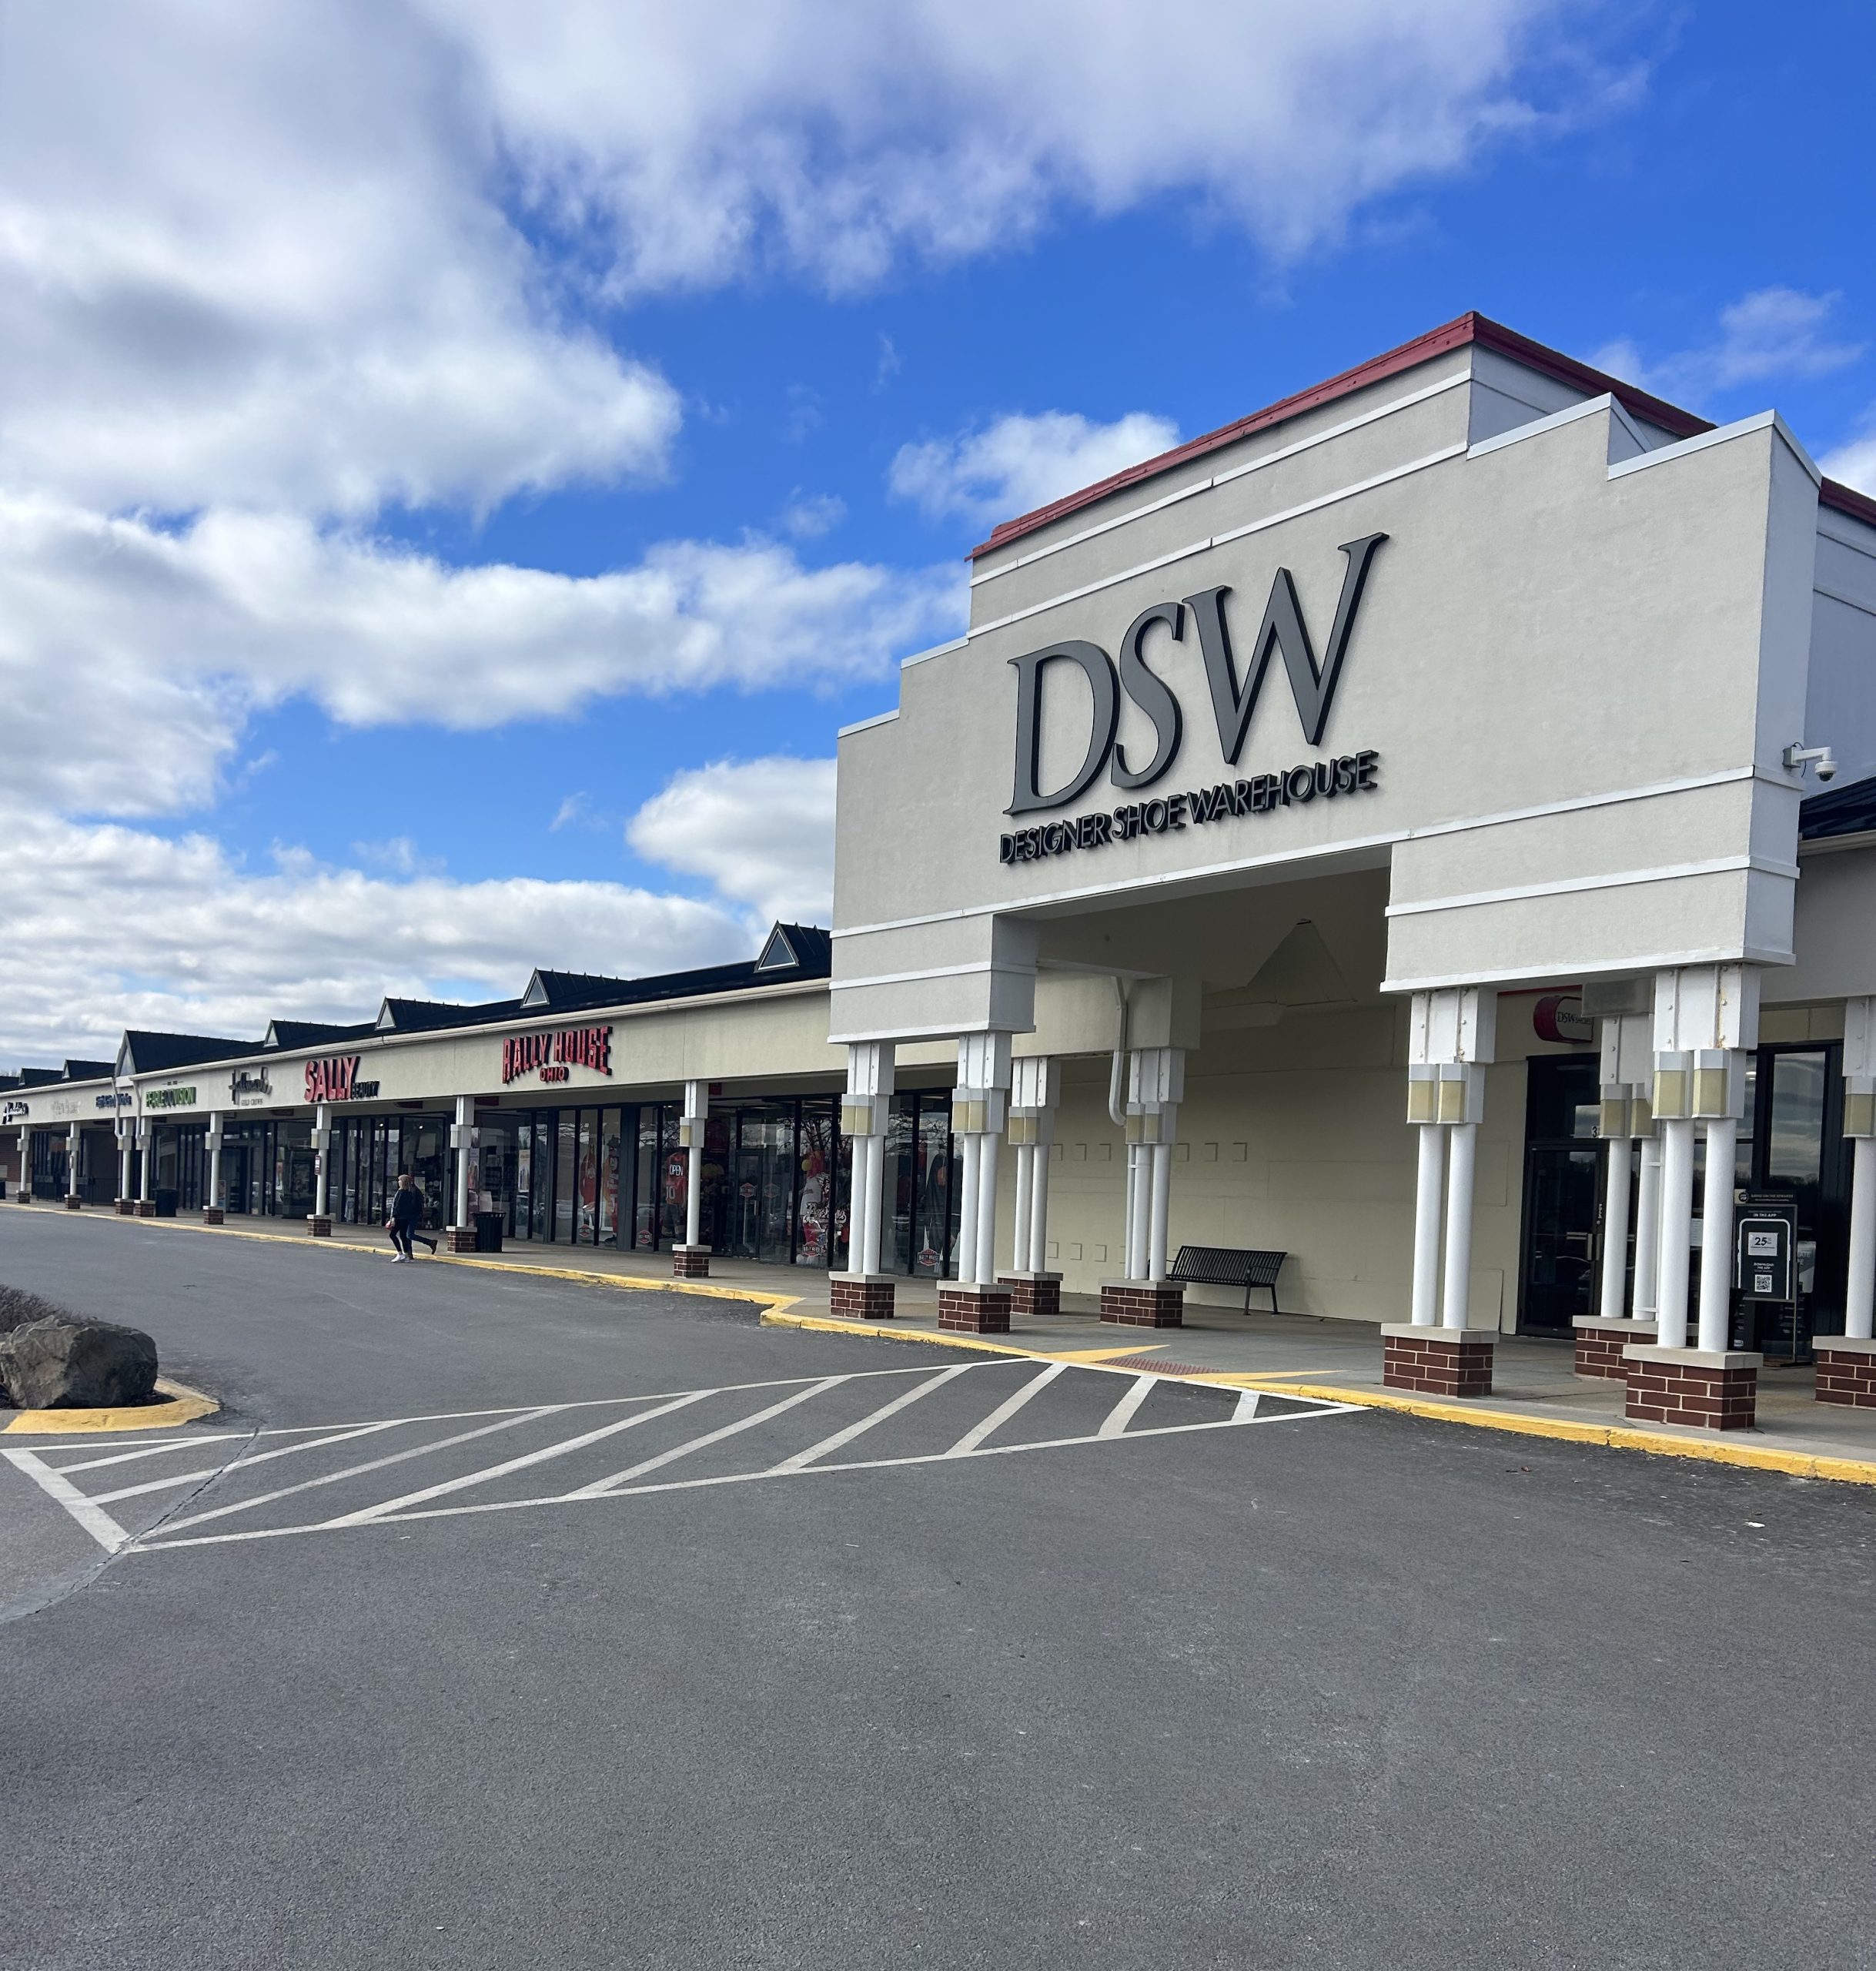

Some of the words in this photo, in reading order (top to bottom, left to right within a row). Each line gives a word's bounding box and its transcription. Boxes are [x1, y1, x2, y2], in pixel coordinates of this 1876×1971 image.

[1002, 532, 1389, 816] DSW
[1000, 812, 1112, 864] DESIGNER
[1112, 794, 1187, 840] SHOE
[1187, 750, 1379, 823] WAREHOUSE
[304, 1056, 360, 1103] SALLY
[352, 1081, 380, 1099] BEAUTY
[503, 1033, 552, 1084] RALLY
[553, 1026, 614, 1076] HOUSE
[540, 1066, 569, 1082] OHIO
